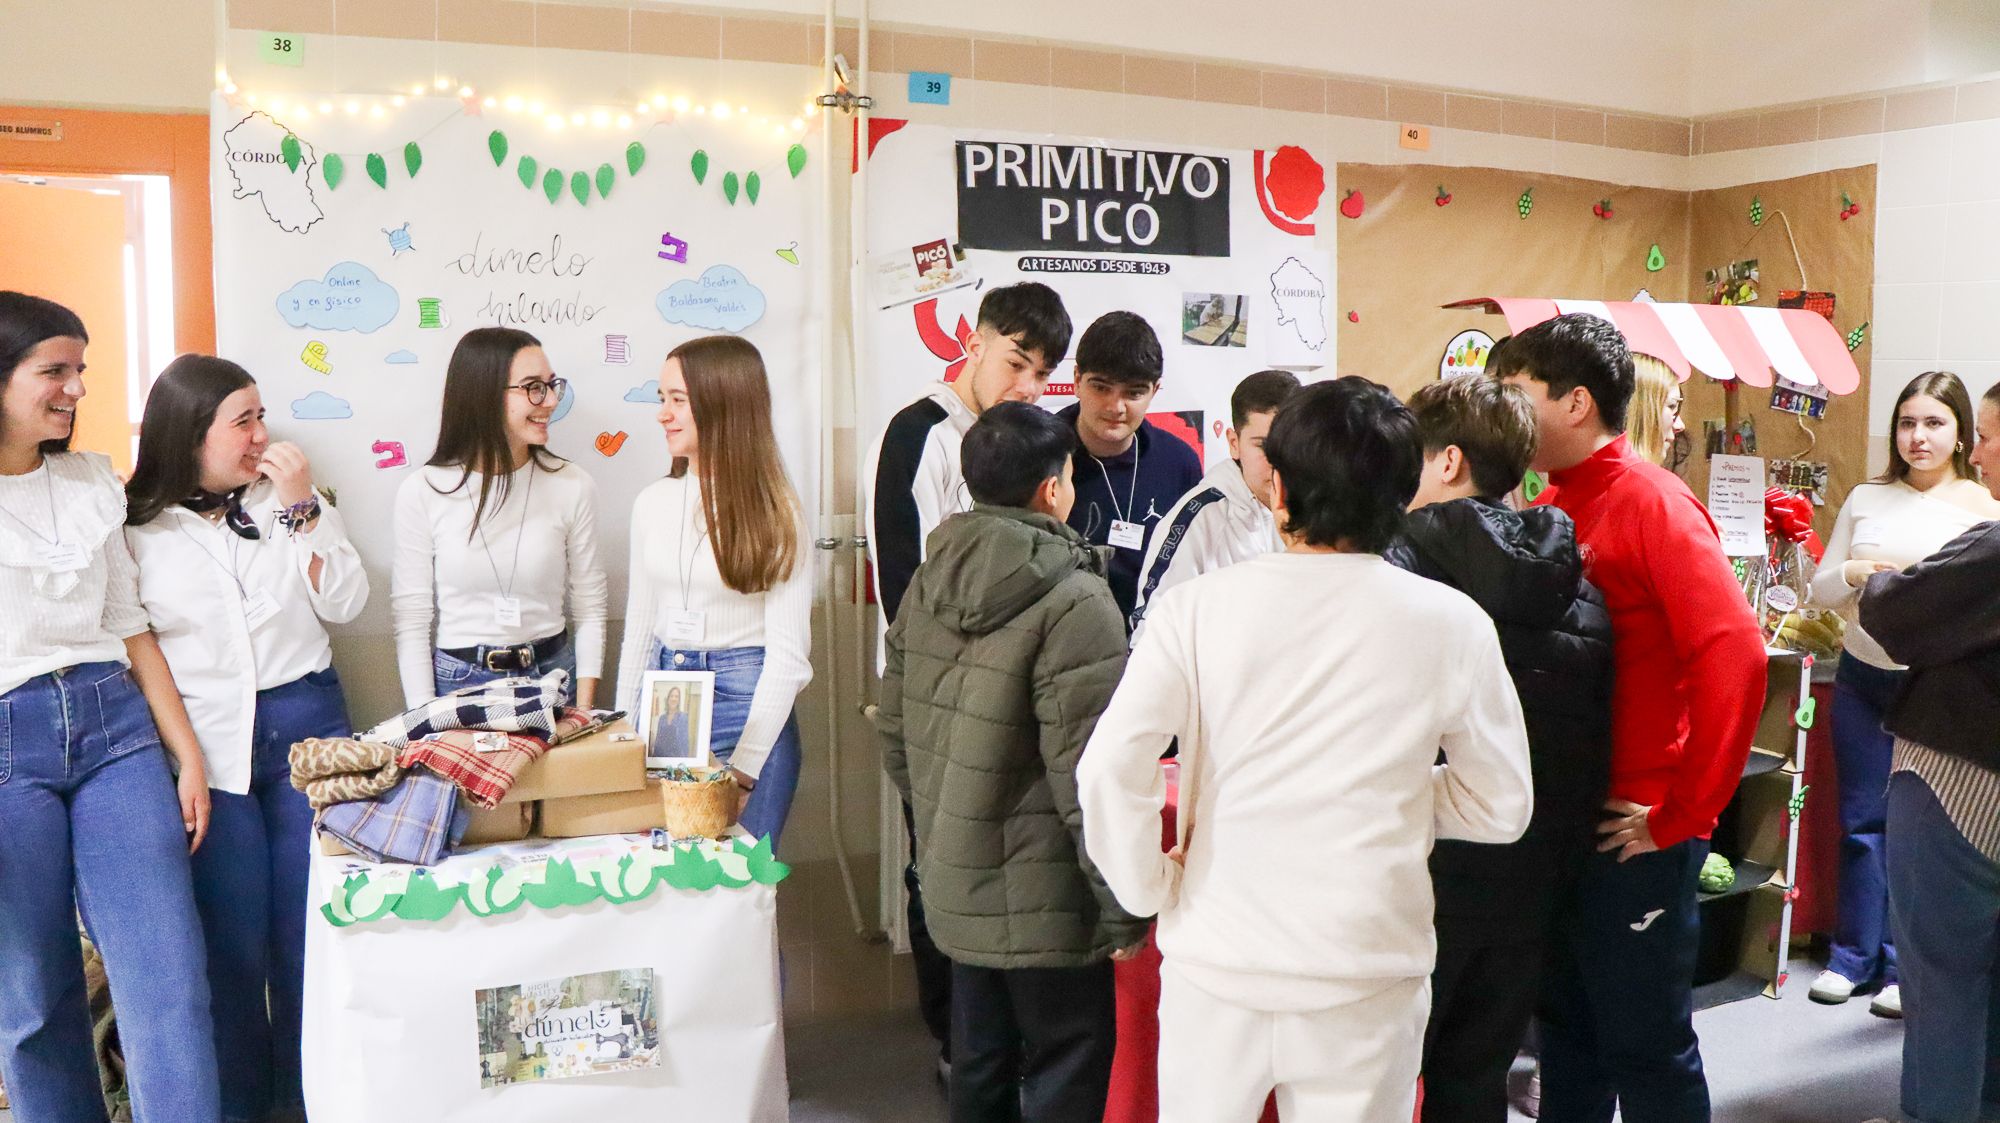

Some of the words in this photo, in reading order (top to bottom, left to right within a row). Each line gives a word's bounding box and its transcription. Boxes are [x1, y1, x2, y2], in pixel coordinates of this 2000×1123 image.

[273, 38, 292, 52] 38
[926, 81, 941, 93] 39
[15, 126, 52, 136] ALUMNOS
[1407, 129, 1418, 140] 40
[232, 149, 307, 166] CÓRDOA
[964, 143, 1219, 199] PRIMITIVO
[1041, 186, 1160, 246] PICÓ
[916, 244, 947, 265] PICÓ
[1021, 258, 1097, 271] ARTESANOS
[1100, 260, 1137, 273] DESDE
[1140, 262, 1167, 274] 1943
[328, 277, 360, 288] Online
[1276, 286, 1321, 298] CÓRDOBA
[293, 298, 300, 312] y
[309, 298, 320, 306] en
[476, 290, 607, 327] hilando
[1159, 524, 1186, 560] FILA
